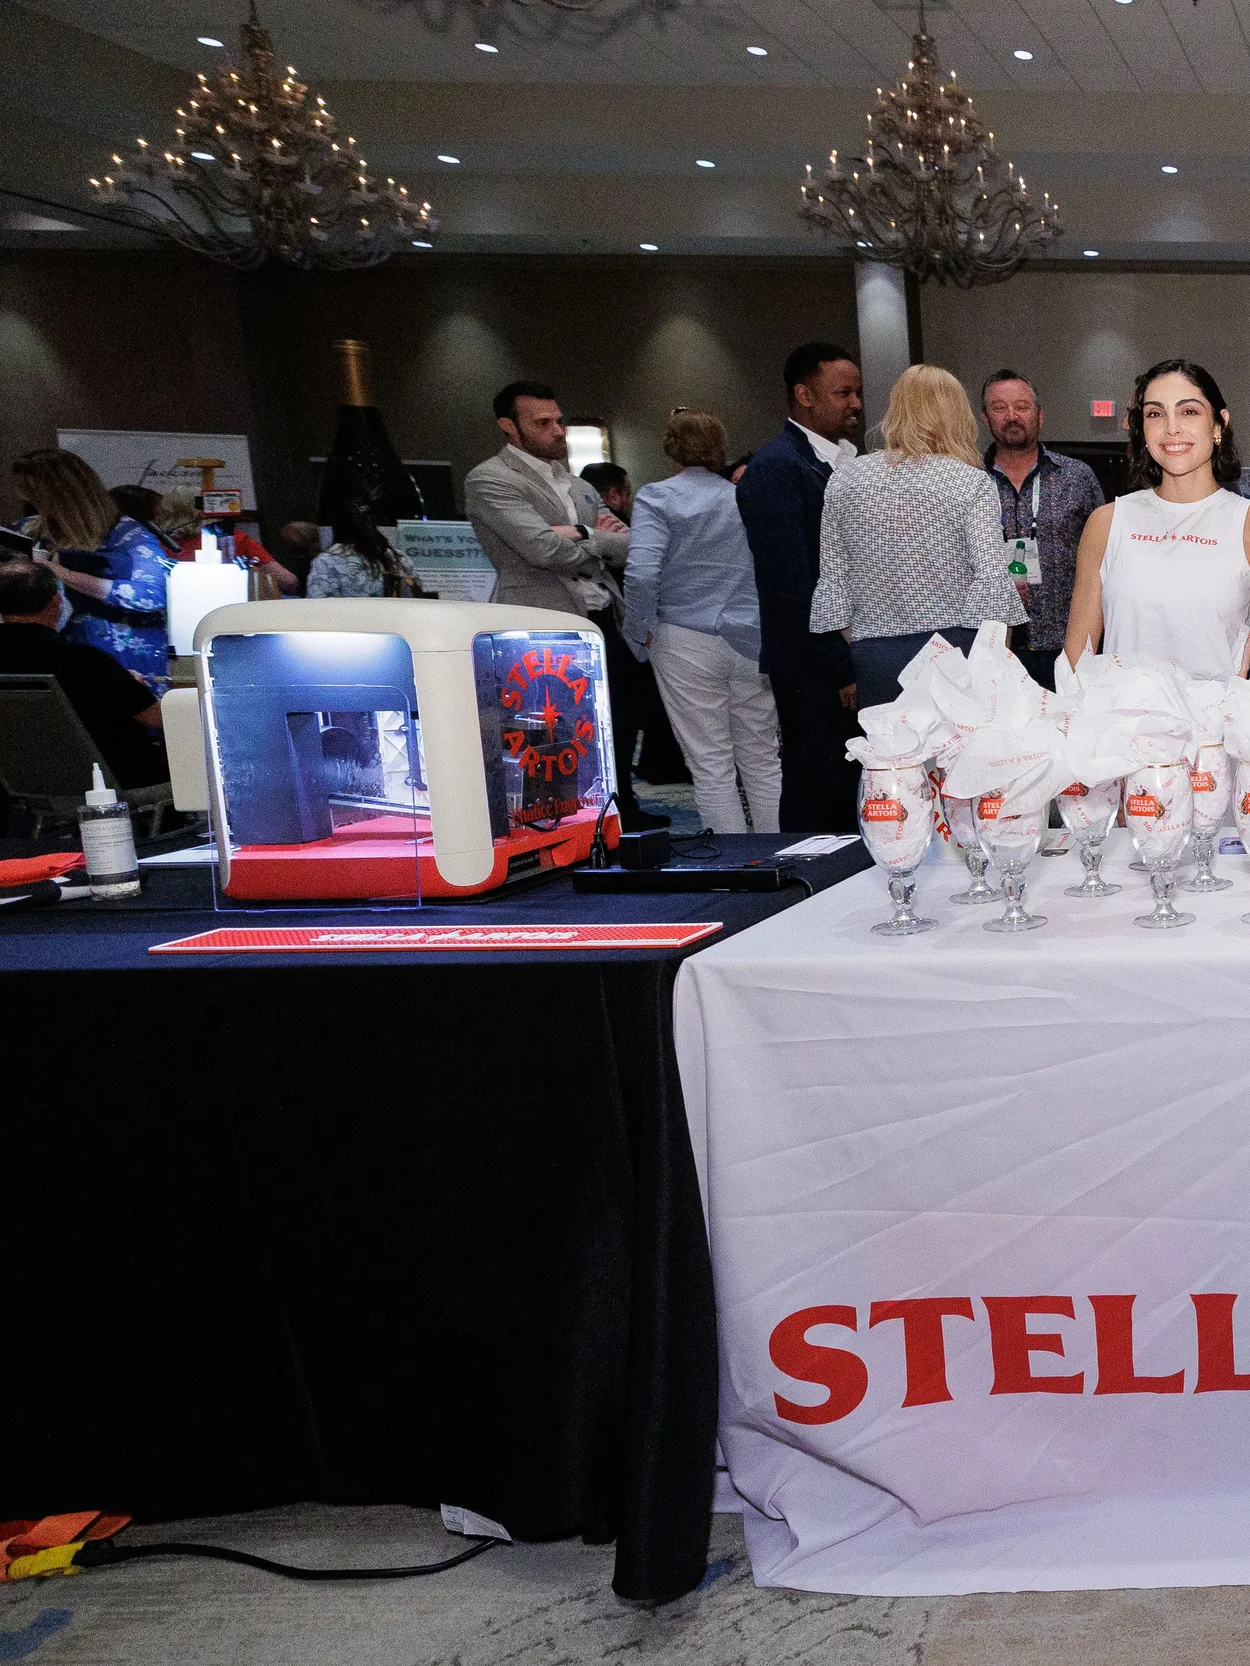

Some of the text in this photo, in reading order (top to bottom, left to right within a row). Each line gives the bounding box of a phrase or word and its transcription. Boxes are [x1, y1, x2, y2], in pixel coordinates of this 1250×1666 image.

[1130, 533, 1218, 546] STELLA ARTOIS
[501, 648, 588, 712] STELLA
[503, 719, 594, 782] ARTOIS
